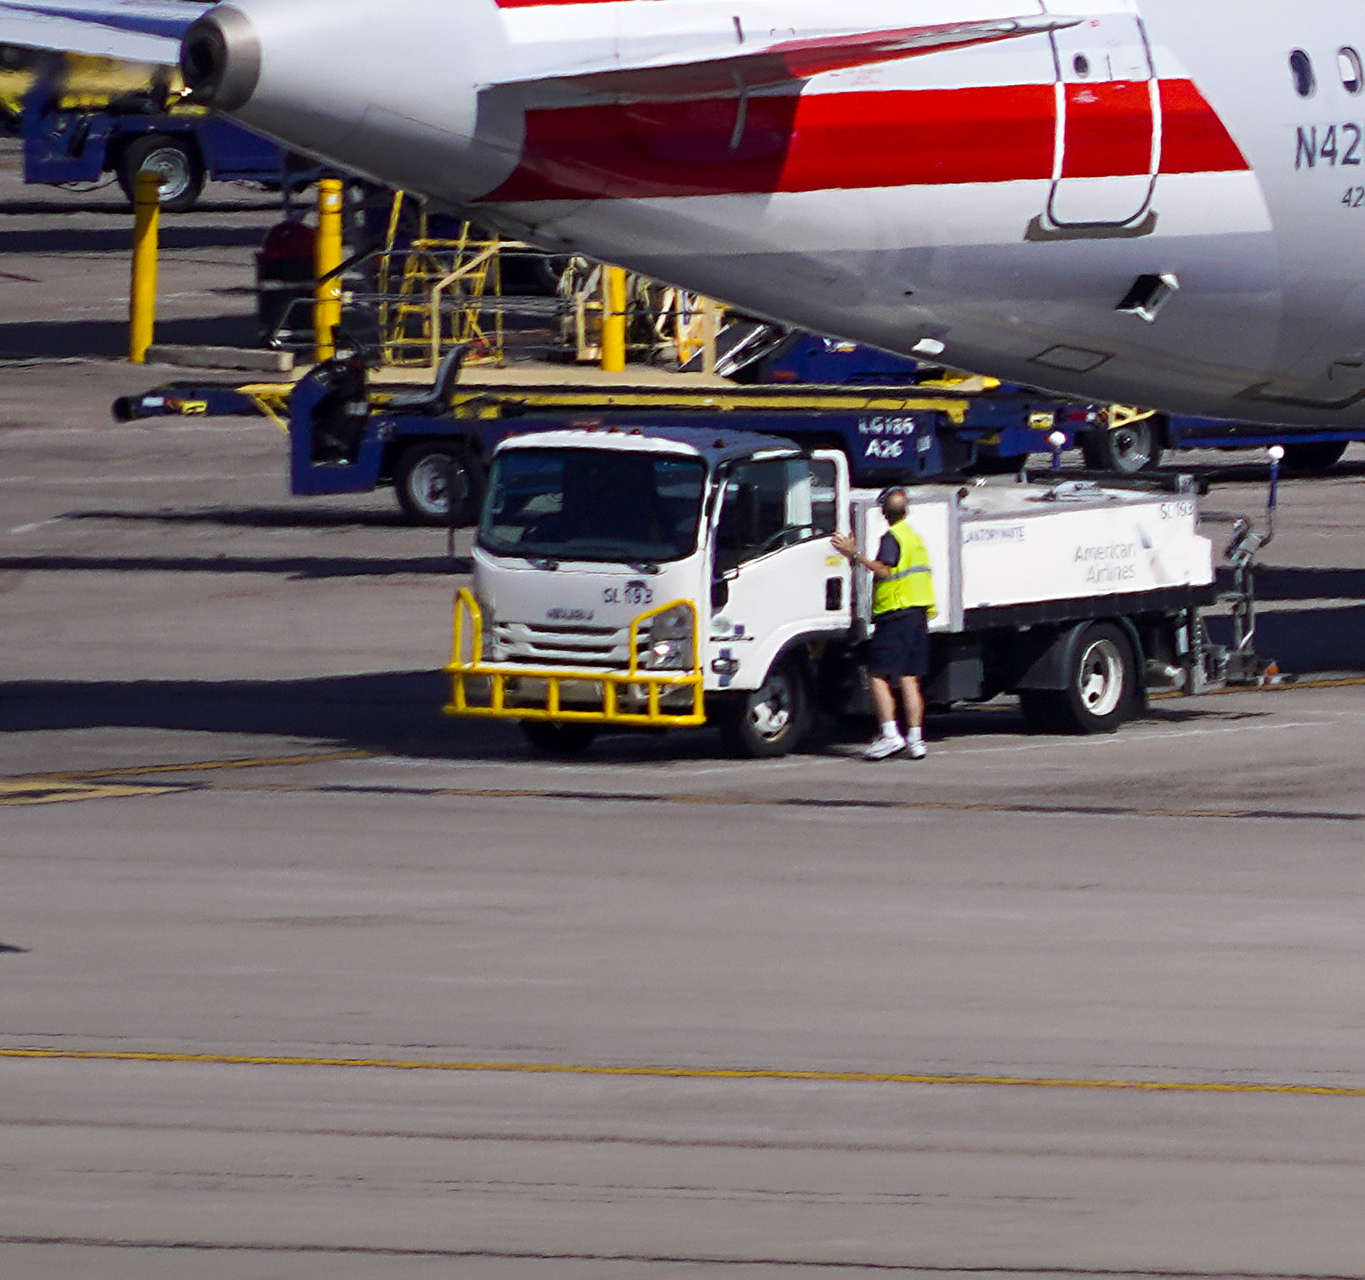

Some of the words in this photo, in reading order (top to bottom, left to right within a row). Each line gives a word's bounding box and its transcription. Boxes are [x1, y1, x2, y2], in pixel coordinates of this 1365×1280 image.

[864, 438, 903, 458] A26
[1074, 541, 1137, 563] American
[1086, 561, 1136, 583] Airlines
